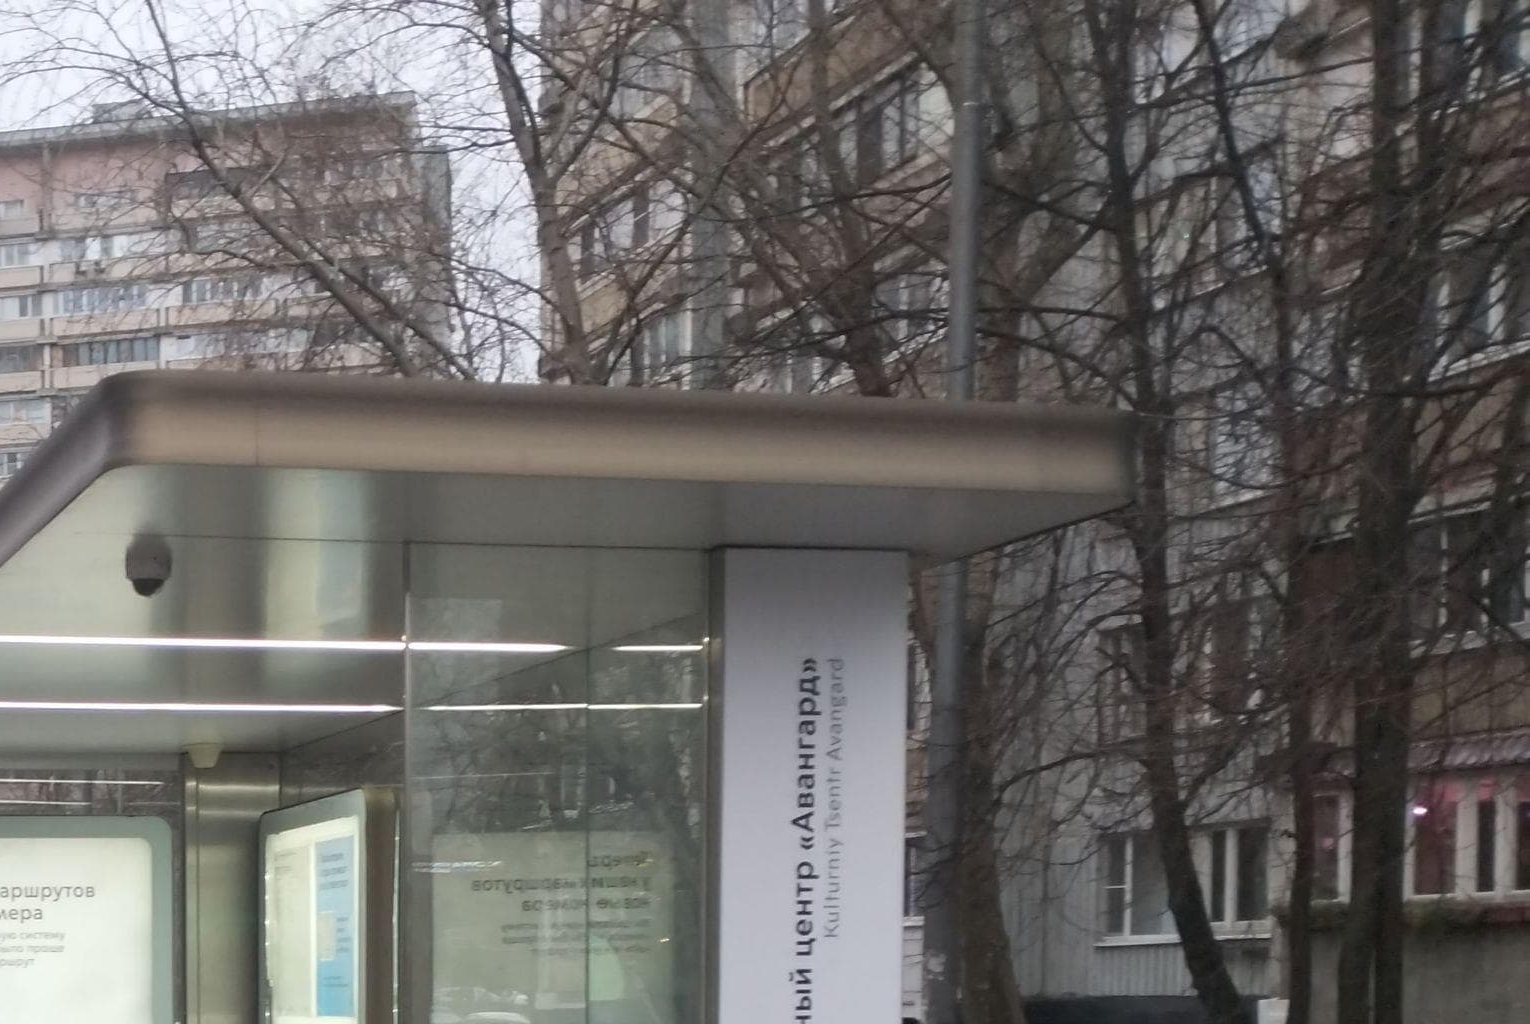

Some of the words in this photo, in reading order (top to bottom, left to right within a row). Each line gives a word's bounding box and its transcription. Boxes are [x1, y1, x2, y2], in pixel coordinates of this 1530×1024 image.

[790, 657, 822, 851] «Авангард»
[826, 658, 848, 761] Avangard
[824, 767, 843, 832] Tsentr
[796, 860, 820, 956] центр
[822, 837, 844, 938] Kulturniy
